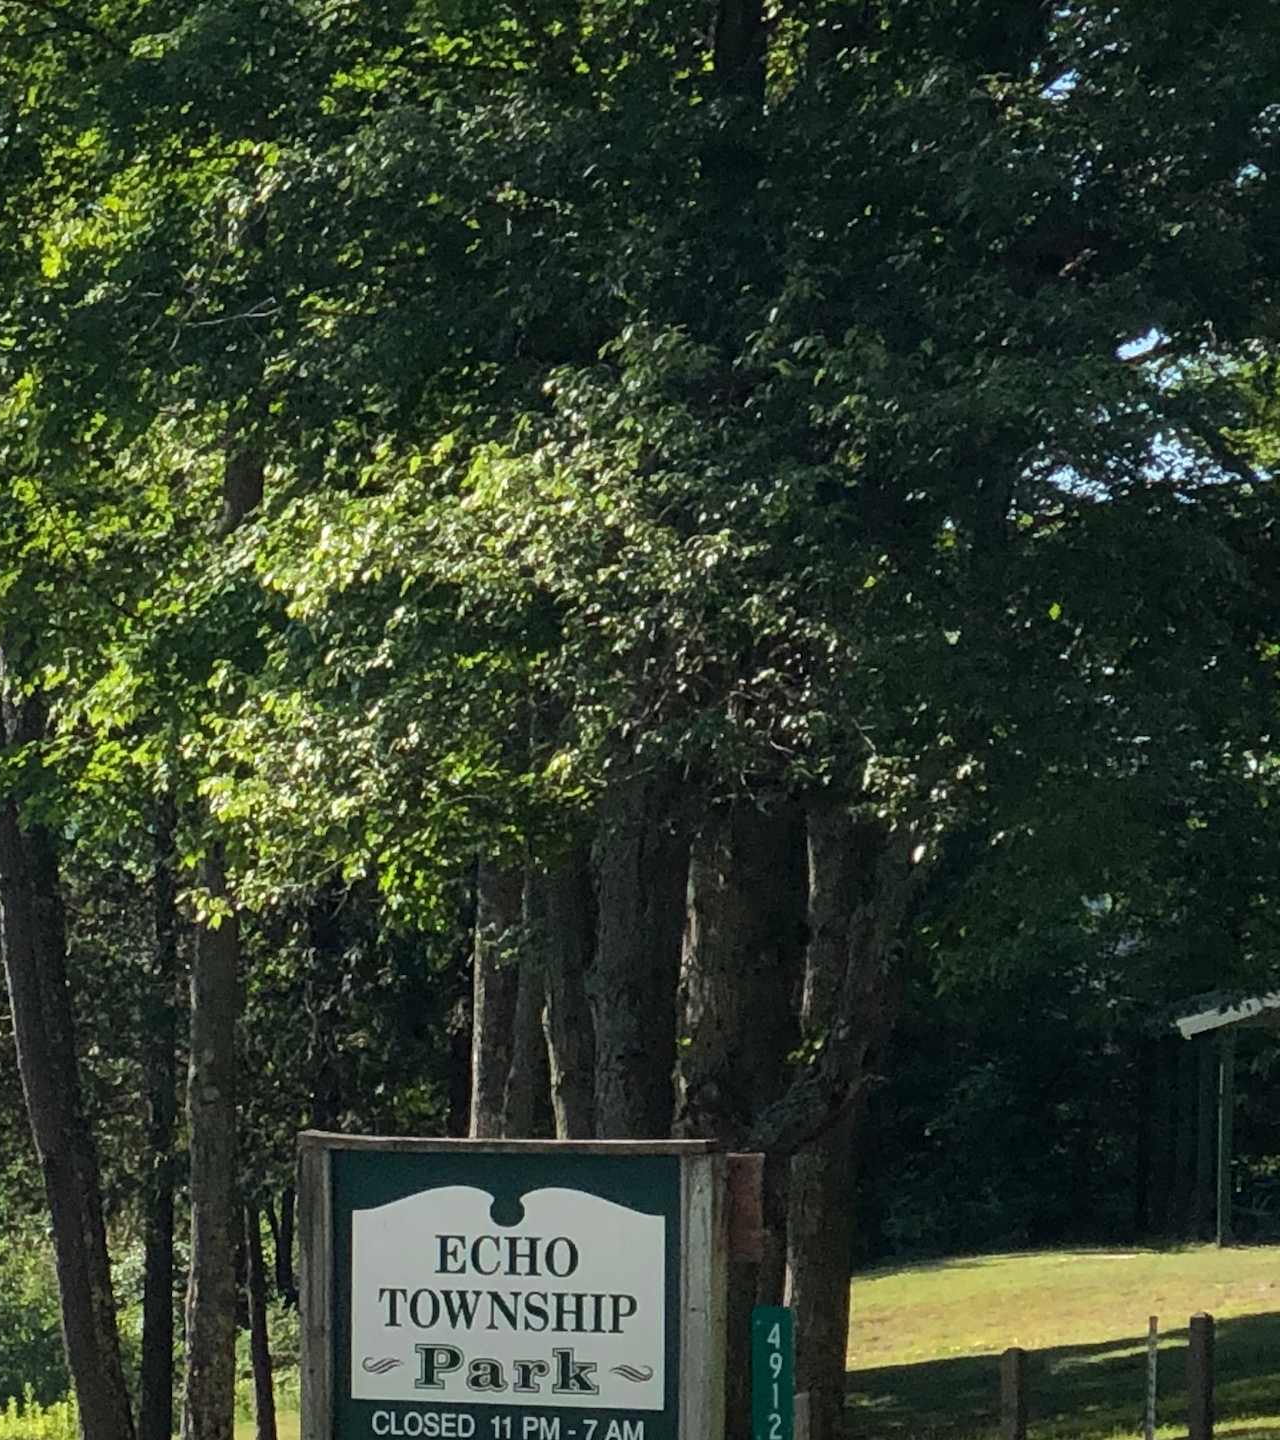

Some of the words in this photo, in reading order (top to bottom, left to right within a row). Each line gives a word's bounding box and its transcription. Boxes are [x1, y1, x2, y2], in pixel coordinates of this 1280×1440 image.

[435, 1234, 579, 1278] ECHO
[378, 1288, 638, 1334] TOWNSHIP
[414, 1343, 600, 1396] Park
[766, 1322, 783, 1440] 4912
[371, 1410, 475, 1438] CLOSED
[490, 1415, 512, 1440] 11
[523, 1416, 560, 1440] PM
